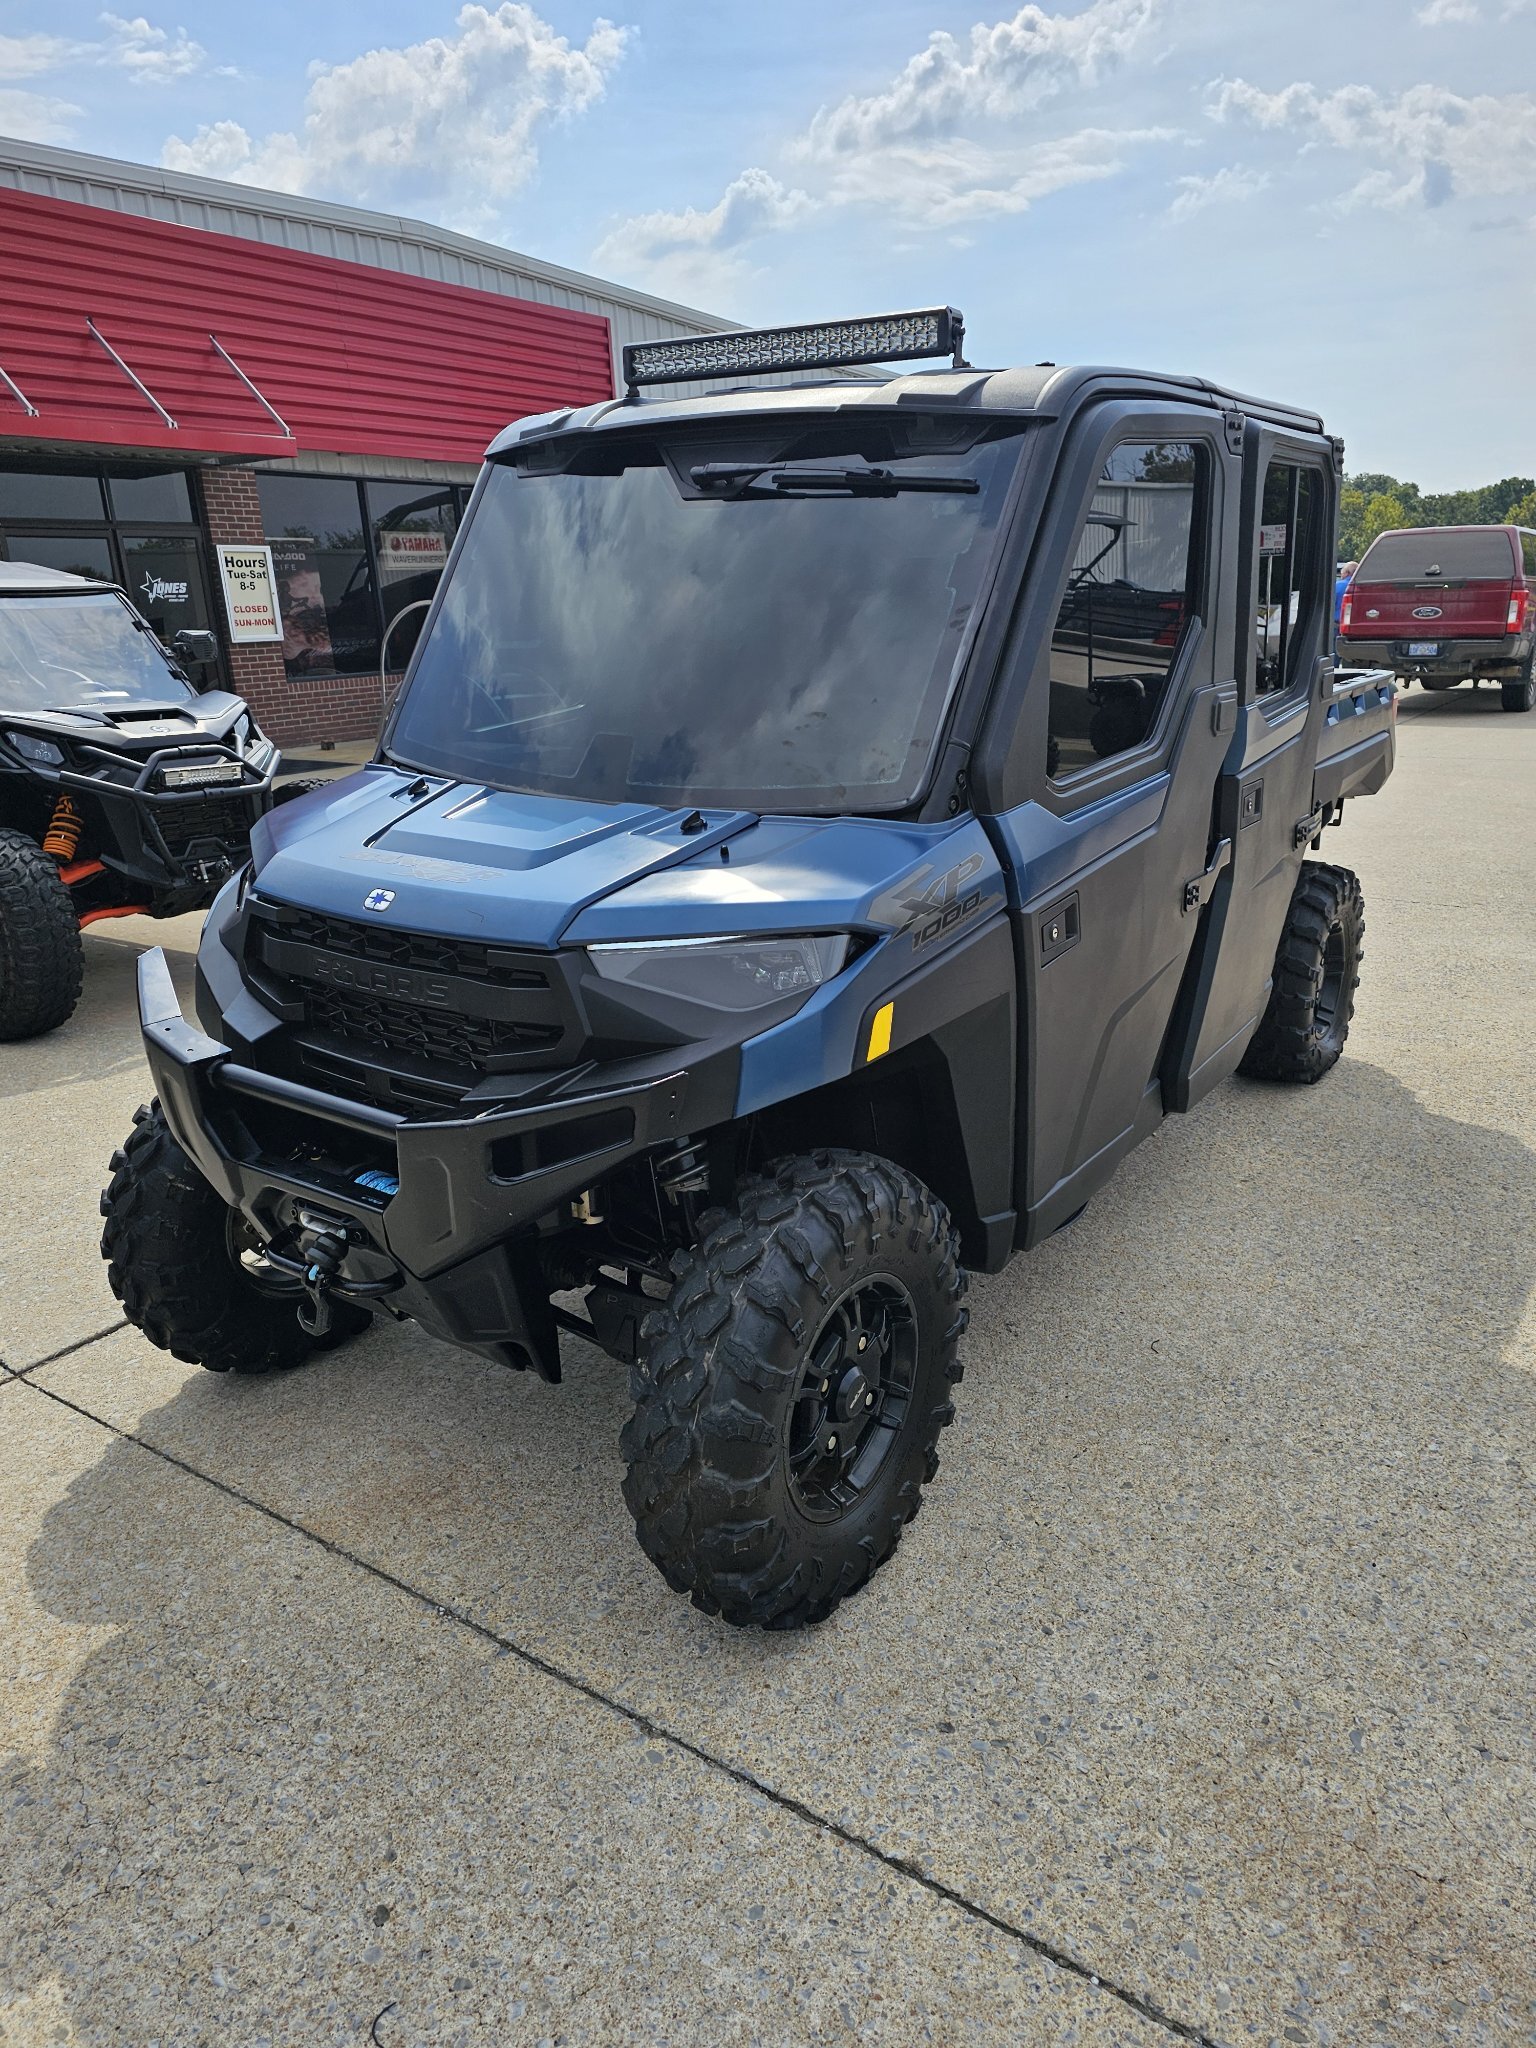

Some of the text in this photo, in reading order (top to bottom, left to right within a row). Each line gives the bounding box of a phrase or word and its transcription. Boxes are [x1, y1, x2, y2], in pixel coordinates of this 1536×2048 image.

[401, 537, 443, 551] YAMAHA
[224, 556, 266, 568] Hours
[227, 570, 267, 579] Tue-Sat
[149, 582, 188, 599] JONES
[240, 581, 256, 591] 8-5
[233, 605, 268, 614] CLOSED
[234, 618, 275, 627] SUN-MON
[894, 852, 984, 930] XP
[912, 891, 980, 951] 1000
[314, 957, 450, 1006] POLARIS
